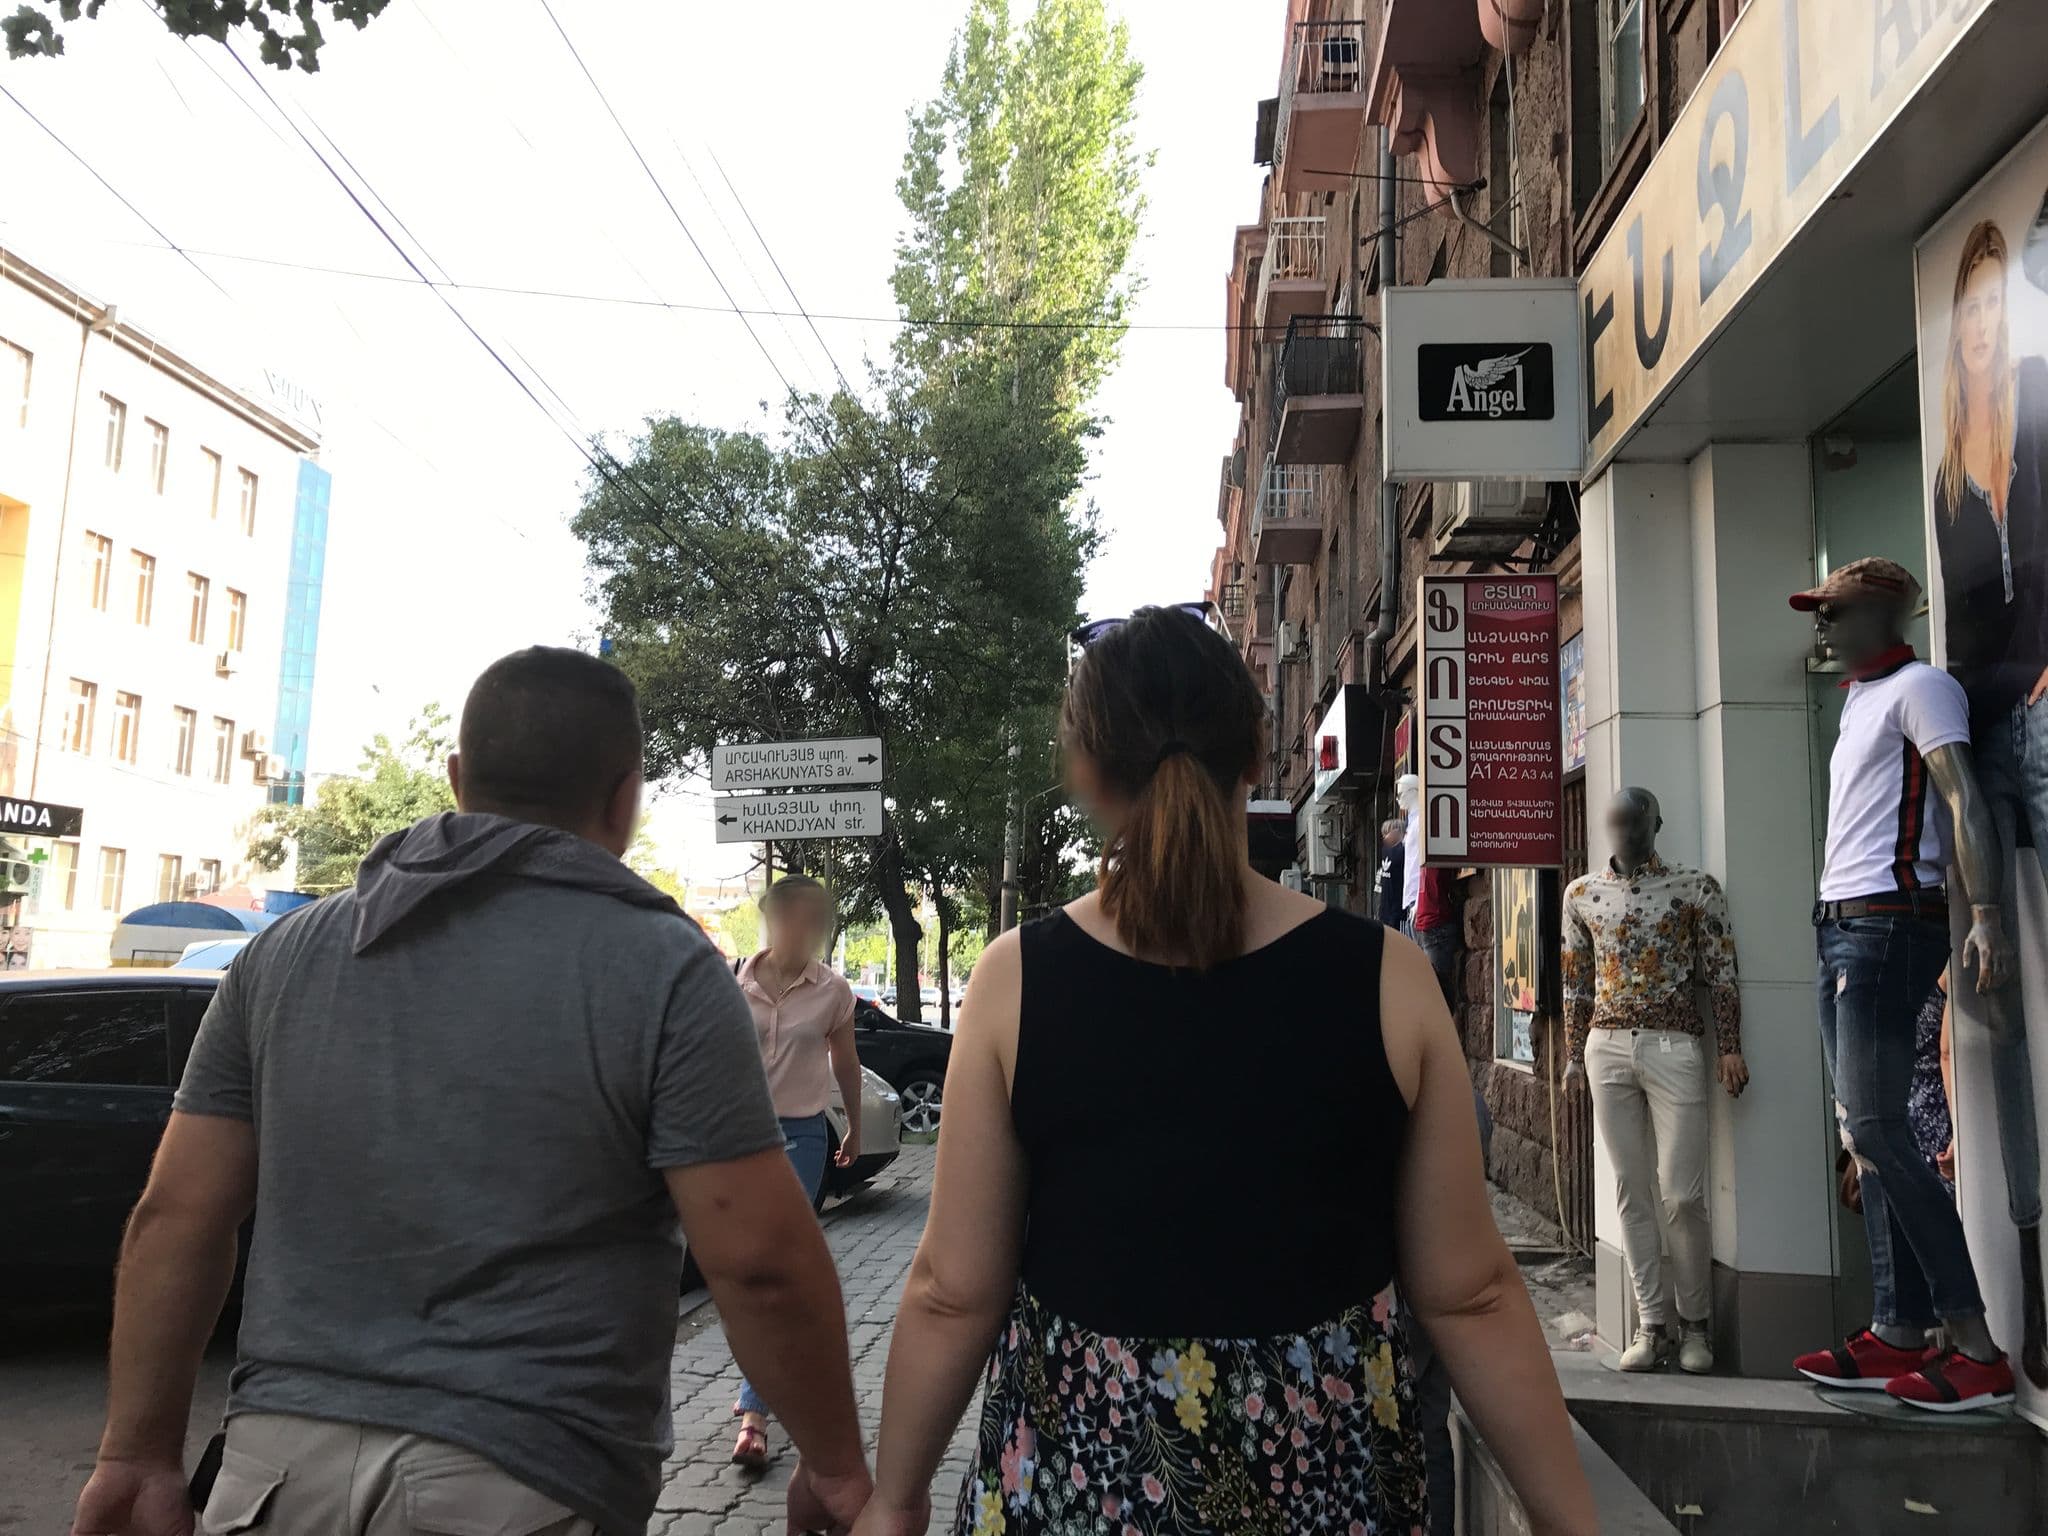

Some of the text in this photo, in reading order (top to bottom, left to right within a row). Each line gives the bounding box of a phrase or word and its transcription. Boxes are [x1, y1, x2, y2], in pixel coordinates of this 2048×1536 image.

[1446, 364, 1526, 418] Angel
[1484, 584, 1537, 599] ՇՏԱՊ
[1468, 631, 1549, 643] ԱՆՁՆԱԳԻՐ
[1468, 652, 1549, 664] ԳՐԻՆ ՔԱՐՏ
[1468, 676, 1550, 686] ՇԵՆԳԵՆ ՎԻԶԱ
[1469, 699, 1552, 711] ԲԻՈՄԵՏՐԻԿ
[1427, 588, 1462, 838] ՖՈՏՈ
[1469, 712, 1546, 721] ԼՈՒՍԱՆԿԱՐՆԵՐ
[1469, 741, 1551, 750] ԼԱՅՆԱՖՈՐՄԱՏ
[725, 748, 848, 766] ԱՐՇԱԿՈՒՆՅԱՑ պող.
[1470, 753, 1553, 762] ՏՊԱԳՐՈՒԹՅՈՒՆ
[725, 764, 854, 783] ARSHAKUNYATS av.
[1470, 763, 1553, 780] A1 A2 A3 A4
[743, 799, 866, 817] ԽԱՆՋՅԱՆ փող.
[1470, 809, 1554, 819] ՎԵՐԱԿԱՆԳՆՈՒՄ
[743, 817, 865, 834] KHANDJYAN str.
